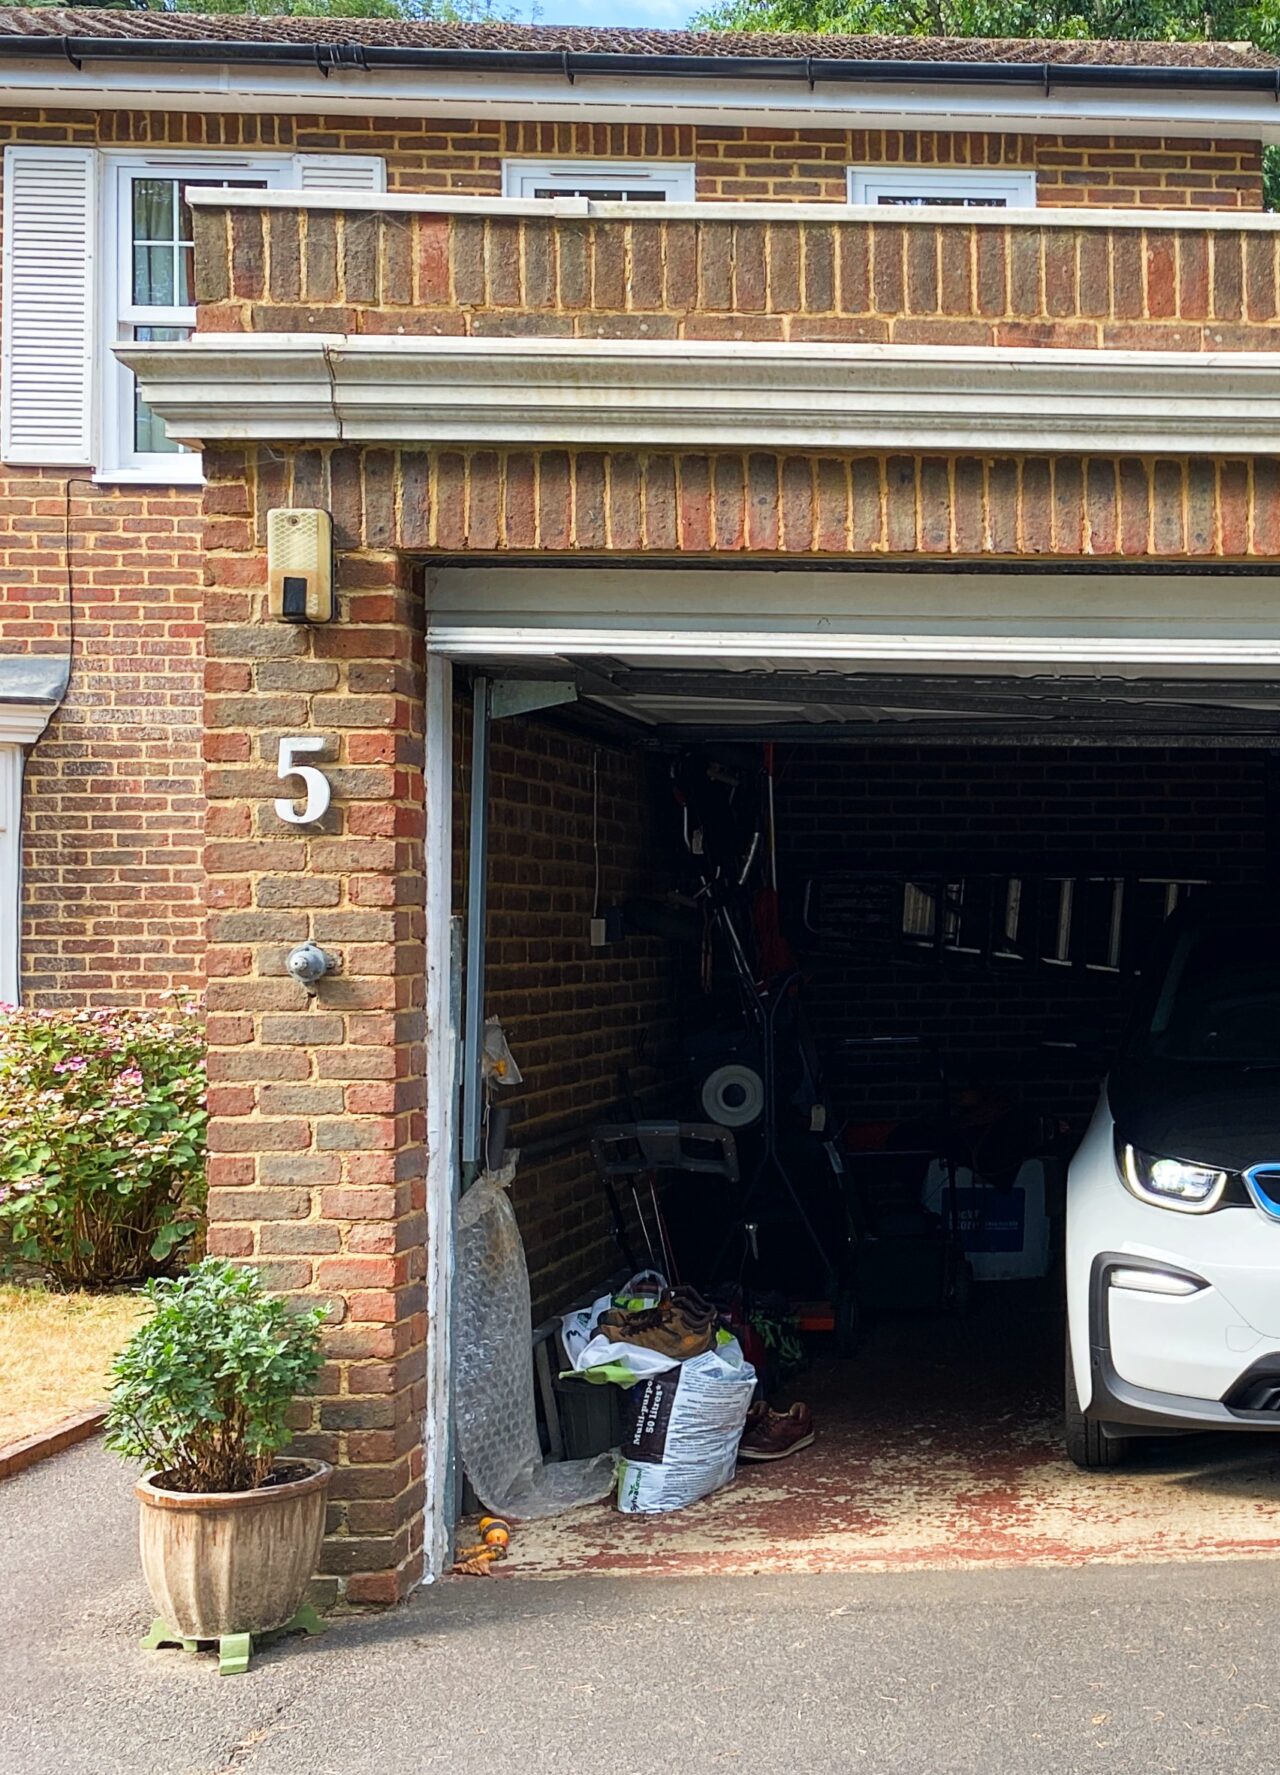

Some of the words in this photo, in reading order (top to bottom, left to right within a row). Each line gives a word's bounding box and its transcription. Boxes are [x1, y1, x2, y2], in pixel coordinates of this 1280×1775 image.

[274, 736, 331, 824] 5
[632, 1379, 653, 1446] Multi-purpo
[645, 1420, 656, 1434] 50
